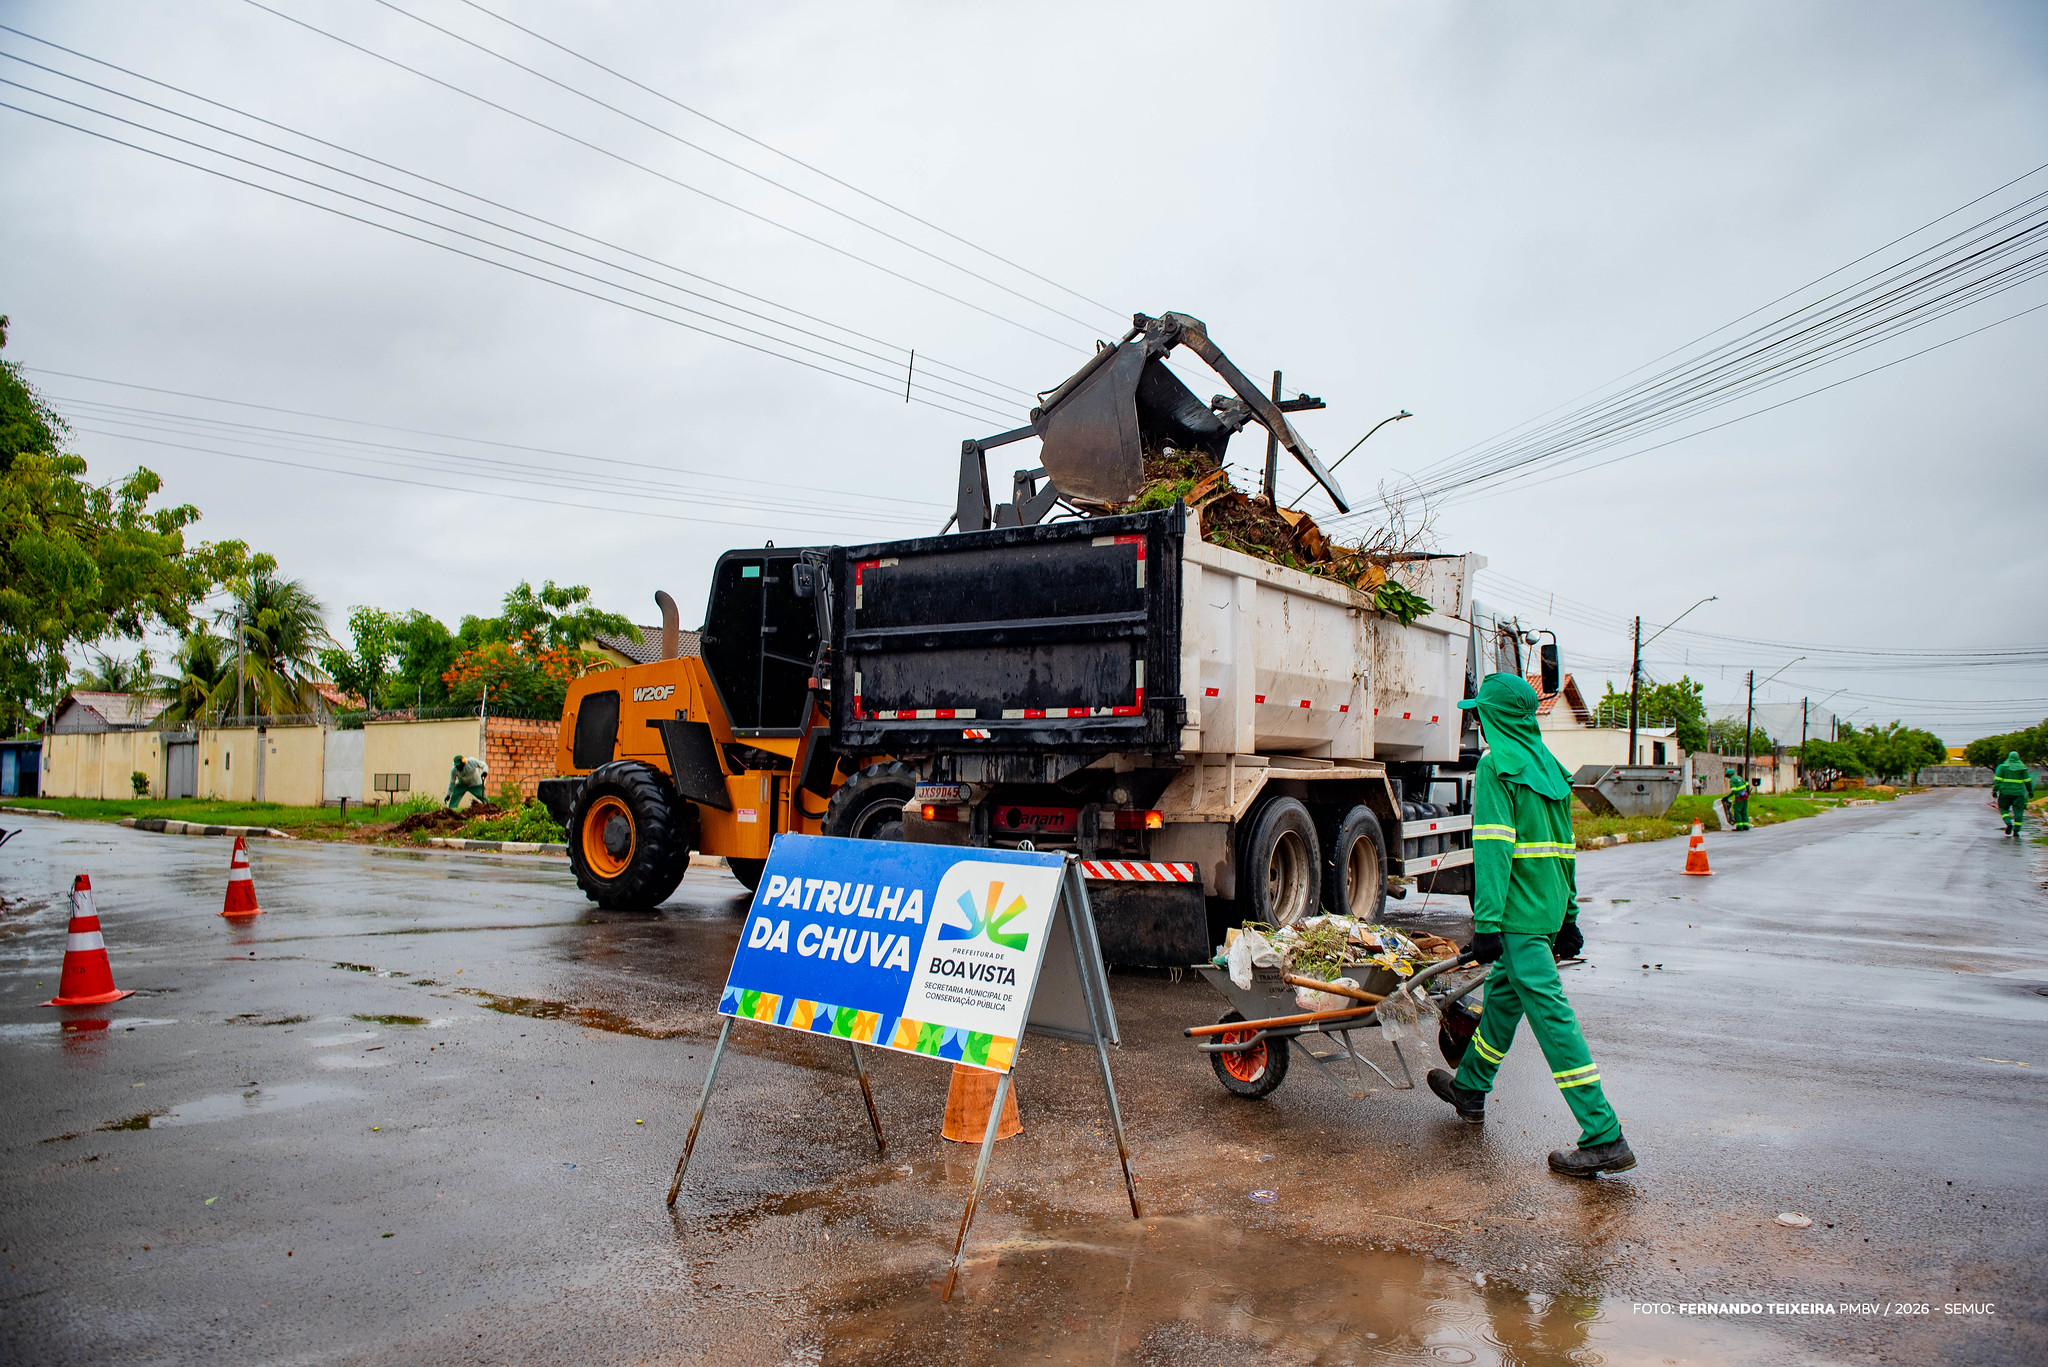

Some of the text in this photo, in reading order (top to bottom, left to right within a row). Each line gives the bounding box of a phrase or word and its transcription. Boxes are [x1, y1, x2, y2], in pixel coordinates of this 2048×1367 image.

[633, 685, 675, 702] W20F
[762, 875, 923, 924] PATRULHA
[748, 916, 910, 972] DA CHUVA
[952, 947, 994, 959] PREFEITURA
[929, 957, 1016, 986] BOA VISTA
[924, 981, 1013, 1002] SECRETARIA MUNICIPAL DE
[925, 991, 1006, 1011] CONSERVAÇÃO PÚBLICA
